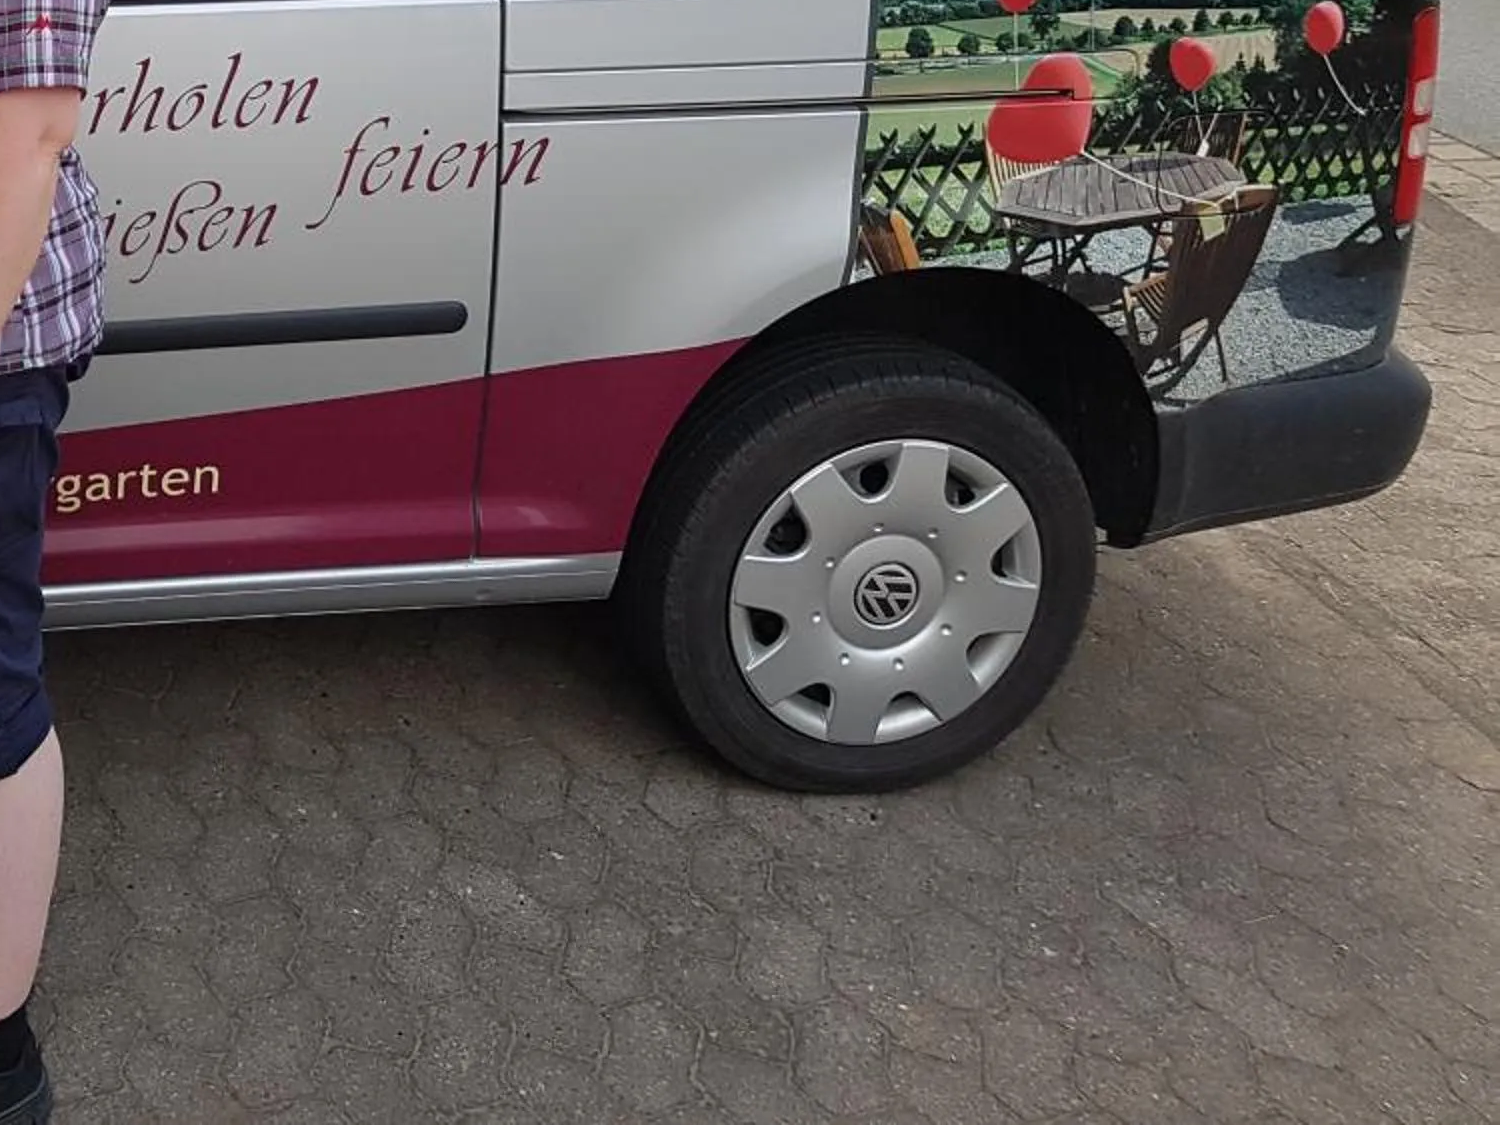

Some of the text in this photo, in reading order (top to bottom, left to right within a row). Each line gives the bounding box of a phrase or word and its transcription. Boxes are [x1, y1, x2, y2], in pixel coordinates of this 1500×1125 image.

[79, 52, 320, 135] rholen
[306, 116, 551, 230] feiern
[102, 180, 278, 284] ießen
[51, 463, 221, 513] garten
